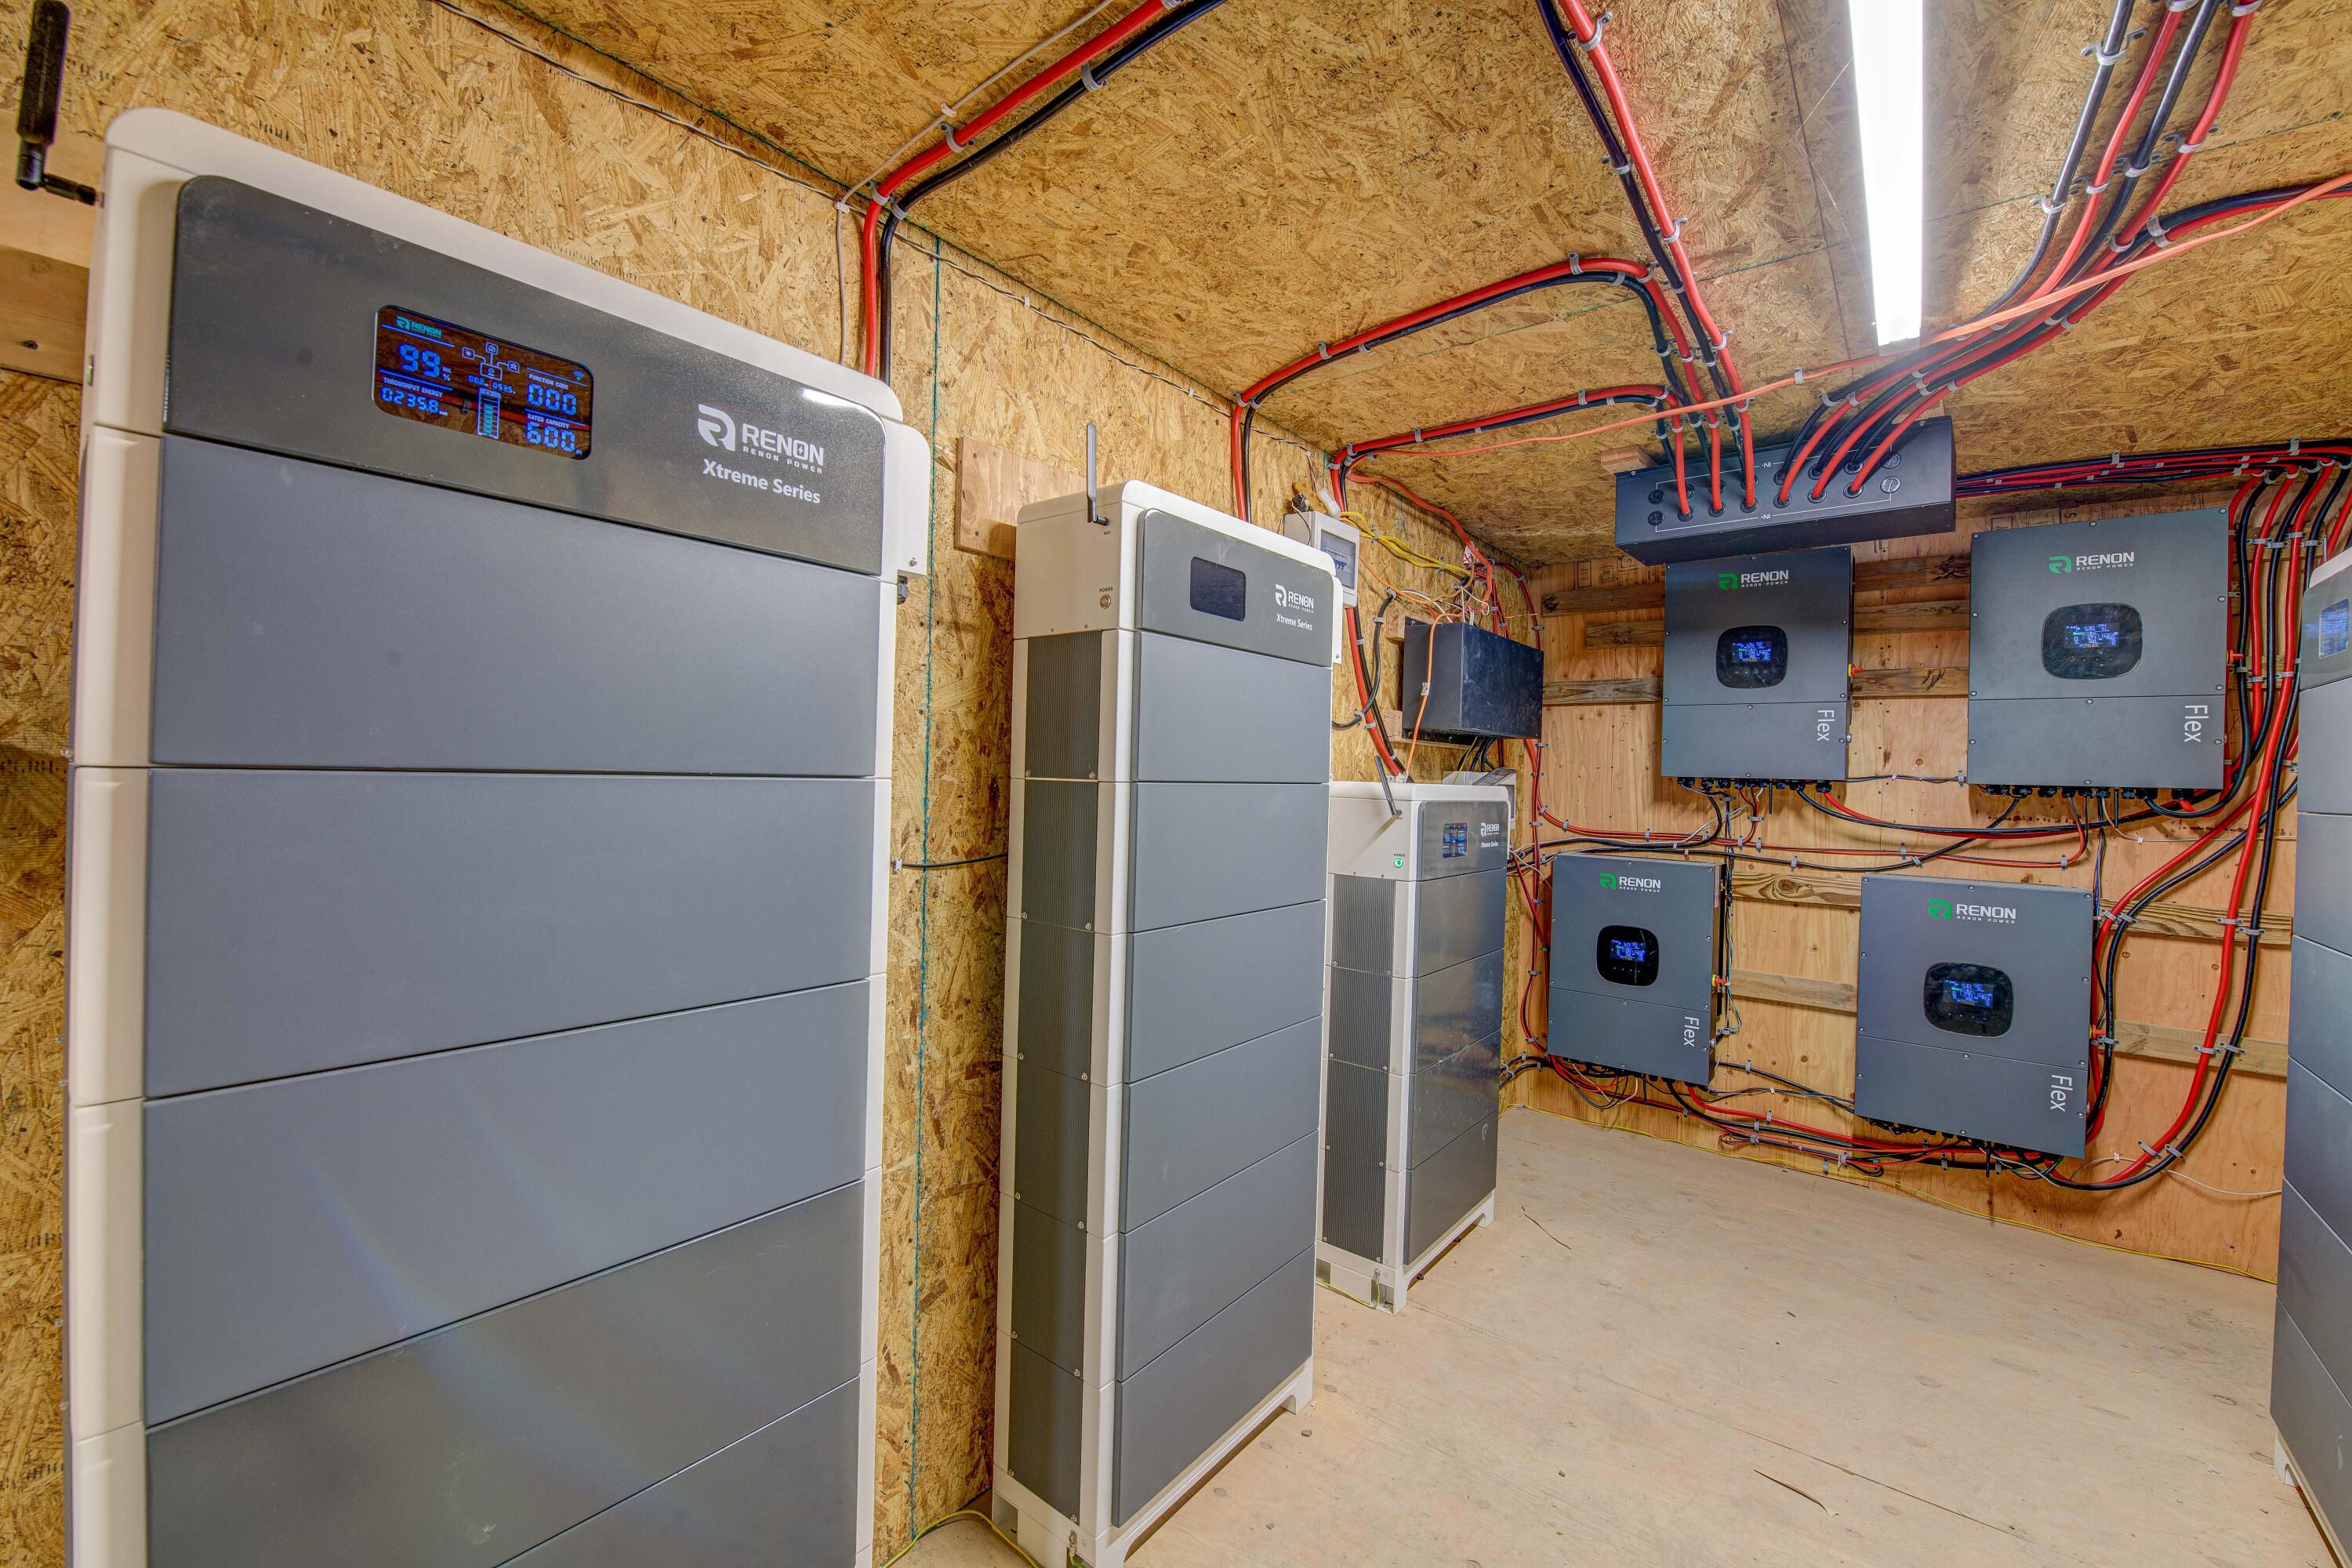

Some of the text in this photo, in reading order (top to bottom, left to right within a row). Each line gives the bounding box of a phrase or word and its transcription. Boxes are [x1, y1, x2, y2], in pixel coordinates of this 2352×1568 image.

[412, 321, 442, 336] RENON
[399, 343, 441, 378] 99
[383, 376, 443, 397] THROUGHPUT ENERGY
[529, 373, 569, 390] FUNCTION CODE
[528, 383, 577, 416] 000
[527, 413, 570, 429] RATED CAPACITY
[526, 421, 576, 452] 600
[742, 423, 823, 466] RENON
[742, 445, 822, 474] RENON POWER
[702, 458, 821, 504] Xtreme Series
[2076, 551, 2135, 567] RENON
[1740, 570, 1789, 583] RENON
[1288, 590, 1314, 609] RENON
[1276, 613, 1313, 631] Xtreme Series
[1817, 710, 1835, 742] Flex
[2184, 705, 2209, 743] Flex
[1619, 876, 1661, 889] RENON
[1956, 903, 2016, 919] RENON
[1683, 1016, 1700, 1047] Flex
[2050, 1074, 2074, 1112] Flex
